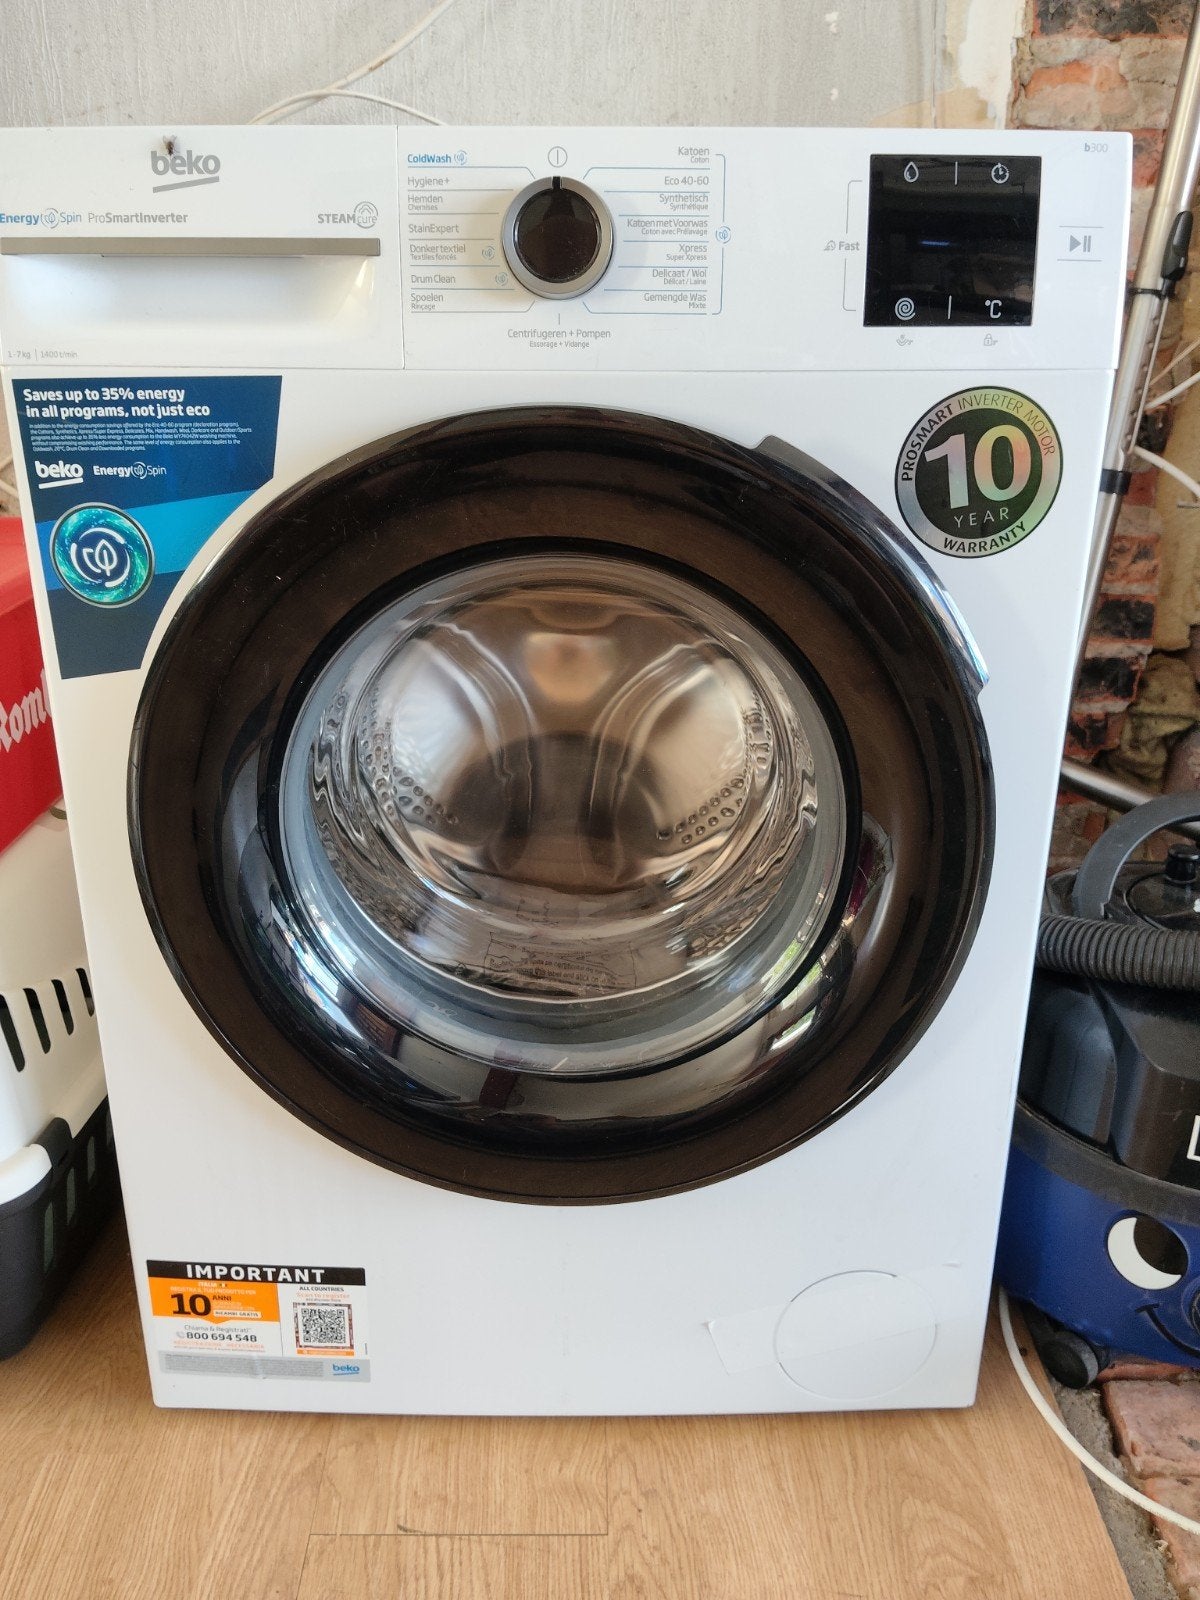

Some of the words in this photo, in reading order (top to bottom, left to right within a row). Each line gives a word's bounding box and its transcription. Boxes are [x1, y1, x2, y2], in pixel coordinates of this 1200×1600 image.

[678, 146, 710, 156] Katoen
[1084, 142, 1108, 152] b300
[151, 150, 220, 176] beko
[407, 153, 452, 163] ColdWash
[407, 176, 450, 187] Hygiene+
[664, 176, 680, 185] Eco
[681, 176, 709, 185] 40-60
[407, 194, 443, 203] Hemden
[660, 194, 709, 204] Synthetisch
[0, 213, 39, 225] Energy
[60, 212, 82, 224] Spin
[88, 212, 188, 224] ProSmartInverter
[627, 219, 656, 228] Katoen
[657, 219, 673, 228] met
[673, 219, 708, 228] Voorwas
[408, 223, 459, 234] StainExpert
[410, 244, 438, 253] Donker
[440, 244, 466, 253] textiel
[679, 244, 707, 254] Xpress
[838, 241, 860, 251] Fast
[666, 253, 685, 261] Super
[686, 253, 707, 261] Xpress
[652, 269, 685, 278] Delicaat
[691, 269, 707, 278] Wol
[411, 275, 432, 284] Drum
[433, 275, 456, 284] Clean
[411, 293, 444, 304] Spoelen
[644, 293, 688, 303] Gemengde
[689, 293, 707, 302] Was
[507, 328, 567, 339] Centrifugeren
[576, 329, 611, 340] Pompen
[529, 340, 558, 348] Essorage
[564, 340, 590, 349] Vidange
[23, 388, 63, 401] Saves
[65, 389, 83, 403] up
[84, 389, 99, 400] to
[101, 387, 135, 400] 35%
[136, 388, 185, 402] energy
[26, 405, 39, 417] in
[41, 405, 58, 417] all
[60, 406, 129, 420] programs,
[131, 404, 155, 417] not
[155, 403, 184, 420] just
[185, 405, 210, 416] eco
[902, 403, 954, 482] PROSMART
[958, 393, 1024, 414] INVERTER
[1023, 409, 1056, 456] MOTOR
[35, 460, 84, 478] beko
[93, 465, 131, 477] Energy
[146, 465, 167, 477] Spin
[924, 424, 1032, 509] 10
[954, 507, 1009, 528] YEAR
[943, 520, 1026, 553] WARRANTY
[187, 1264, 325, 1283] IMPORTANT
[171, 1293, 211, 1316] 10
[184, 1324, 208, 1332] Chiama
[186, 1331, 209, 1340] 800
[211, 1333, 233, 1341] 694
[235, 1334, 257, 1343] 548
[332, 1363, 360, 1372] beko
